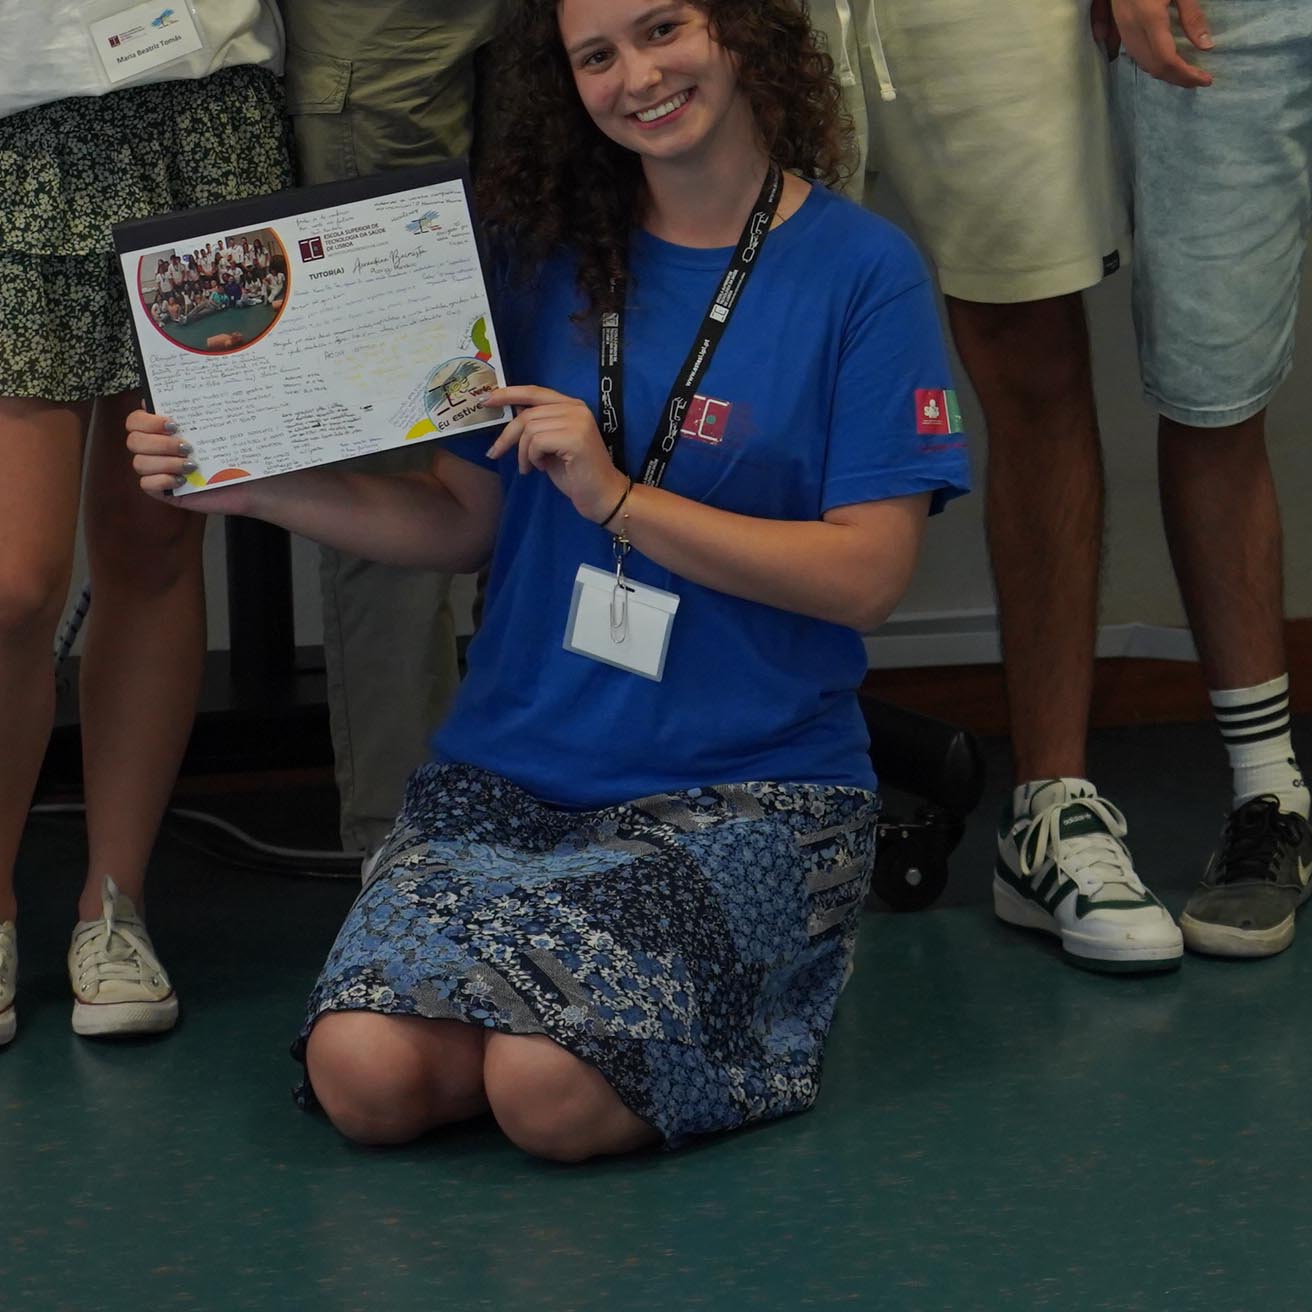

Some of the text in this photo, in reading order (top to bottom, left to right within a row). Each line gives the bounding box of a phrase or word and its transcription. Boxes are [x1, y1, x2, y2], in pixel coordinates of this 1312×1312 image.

[308, 266, 345, 281] TUTOR(A)
[437, 402, 484, 431] Eu estive
